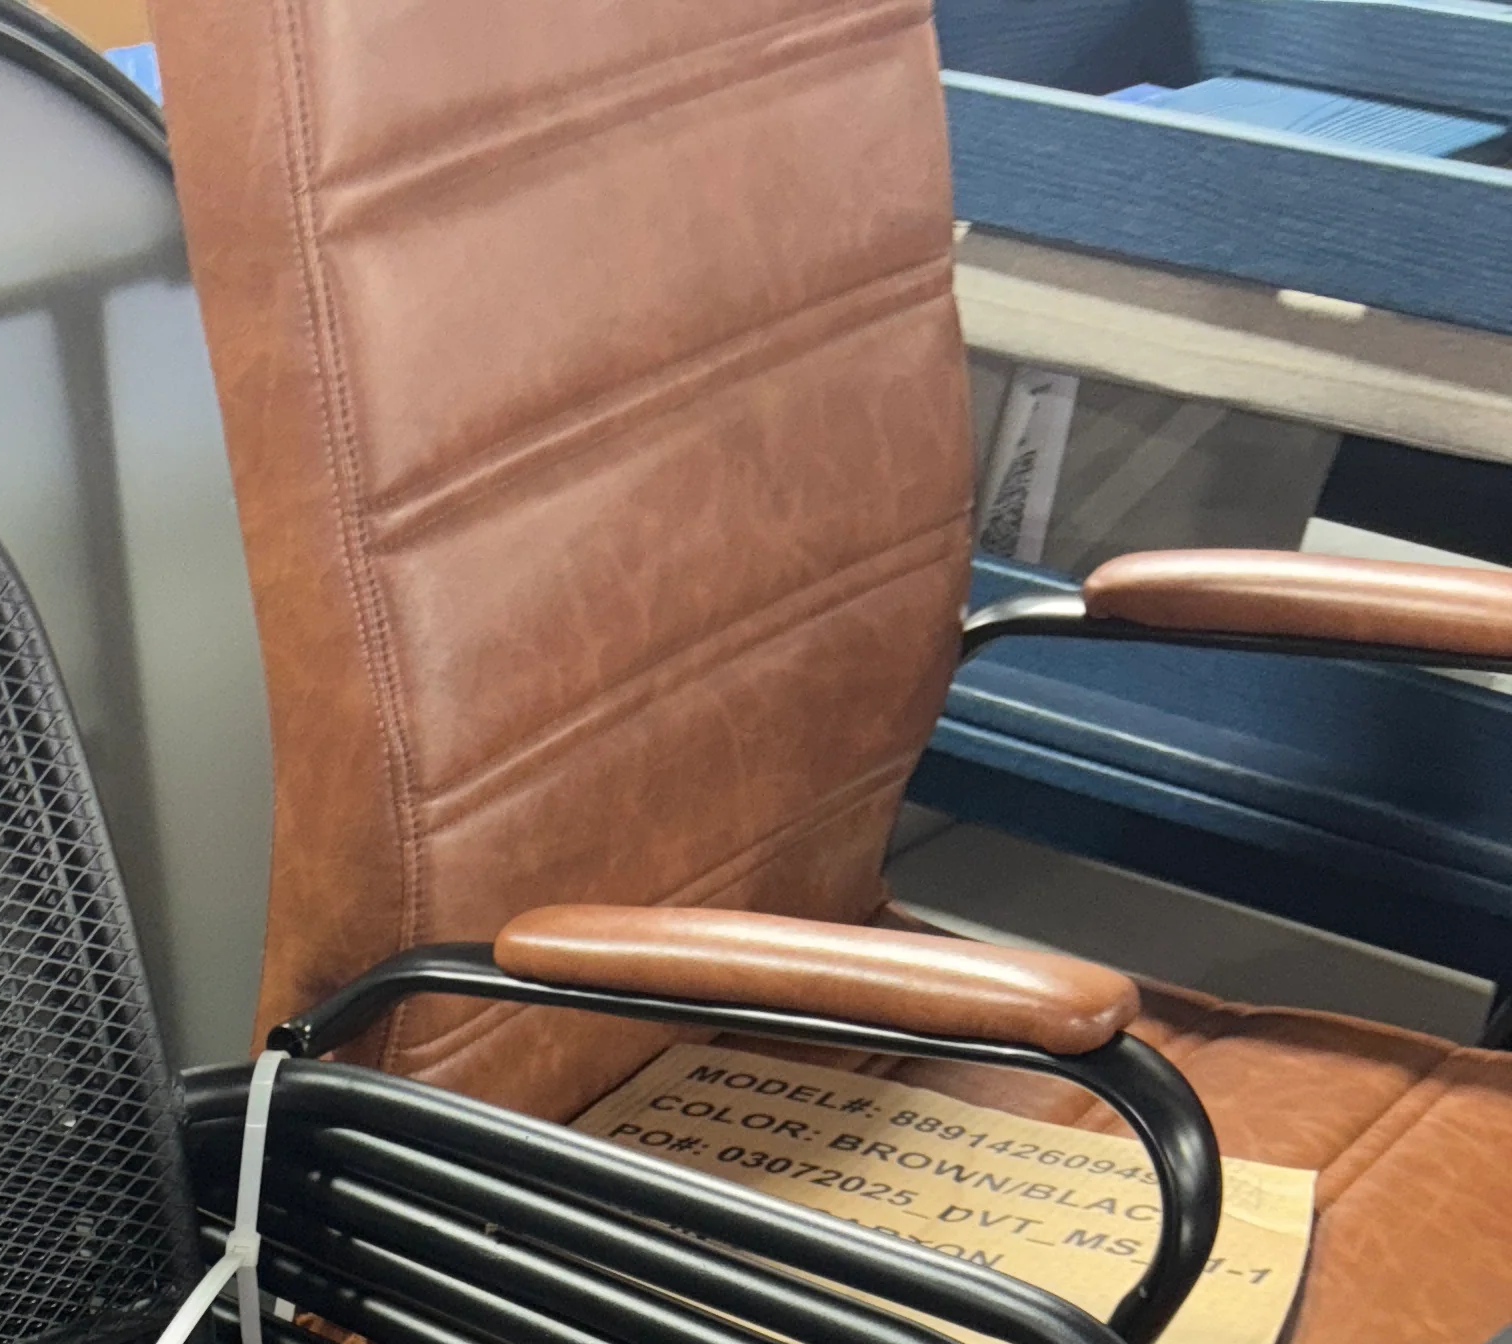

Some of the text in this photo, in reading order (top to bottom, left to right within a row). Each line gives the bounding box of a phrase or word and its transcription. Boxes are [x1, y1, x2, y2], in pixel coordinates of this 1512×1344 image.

[686, 1064, 881, 1119] MODEL#:
[608, 1122, 709, 1155] PO#:
[649, 1094, 1162, 1224] COLOR: BROWN/BLAC
